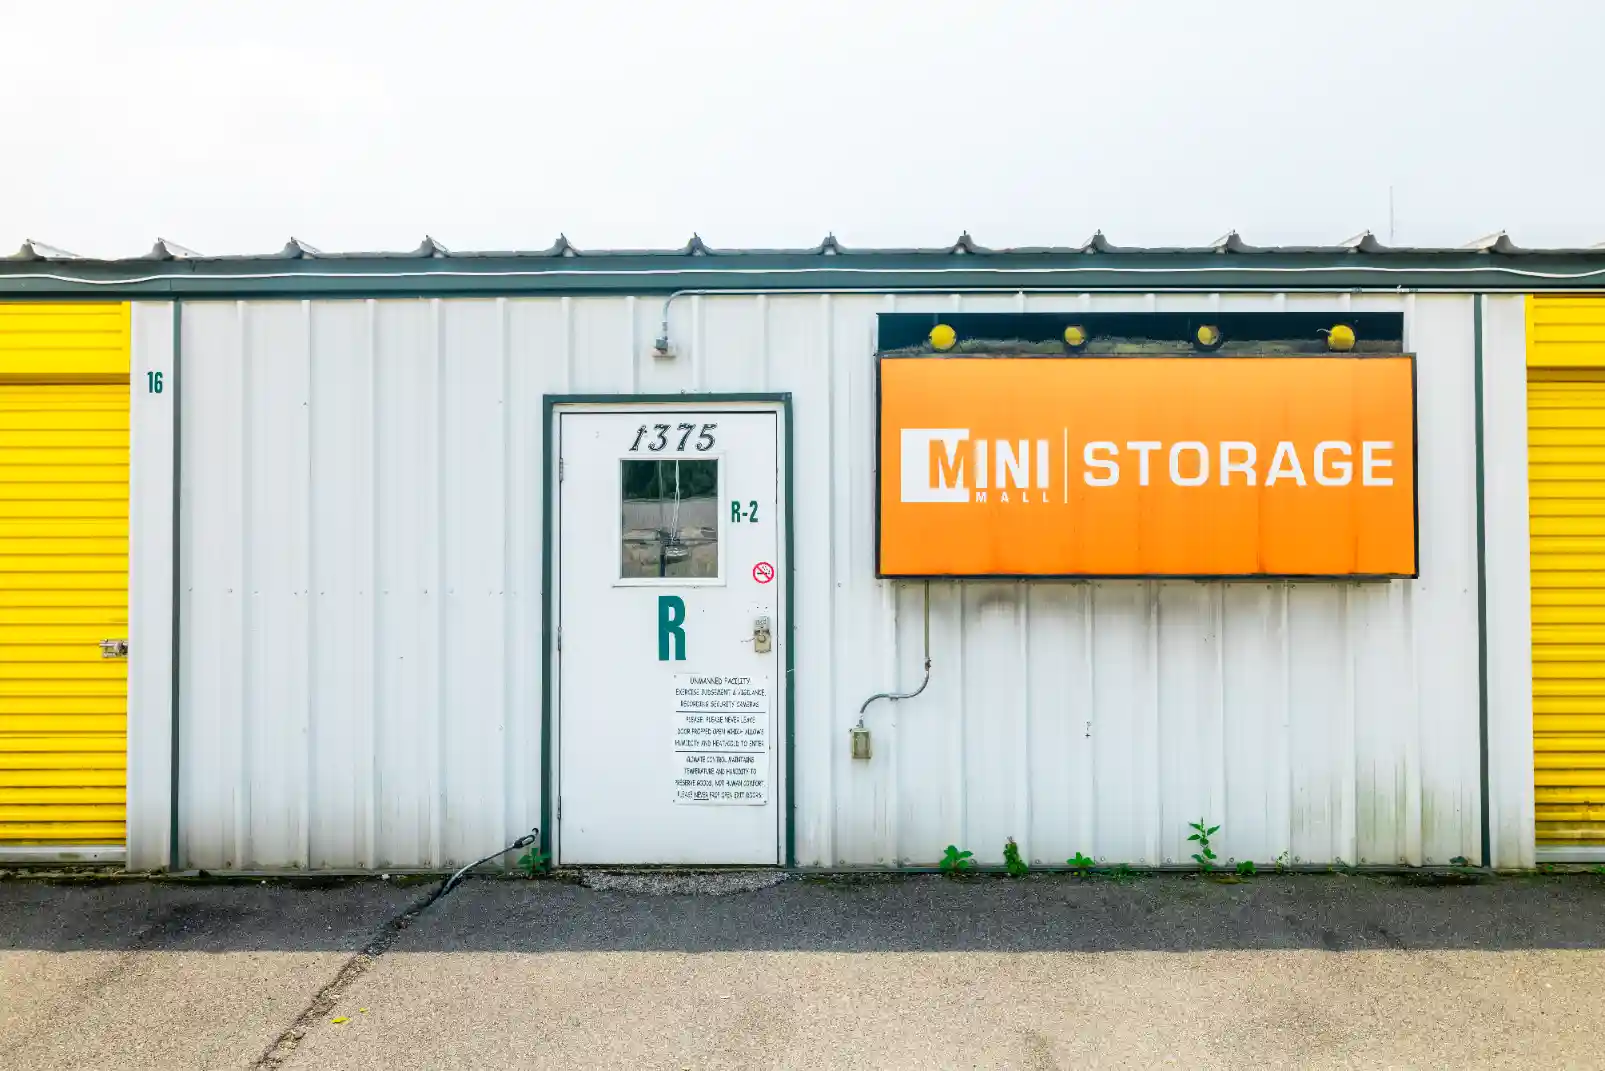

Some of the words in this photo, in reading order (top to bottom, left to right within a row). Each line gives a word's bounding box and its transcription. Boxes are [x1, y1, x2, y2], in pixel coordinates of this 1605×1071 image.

[147, 371, 163, 393] 16
[628, 422, 718, 452] 1375
[928, 438, 1050, 490] MINI
[1082, 440, 1394, 488] STORAGE
[976, 491, 1050, 503] MALL
[731, 500, 759, 523] R-2
[658, 595, 687, 661] R
[676, 688, 700, 696] EXERCISE
[690, 677, 722, 686] UNMANNED
